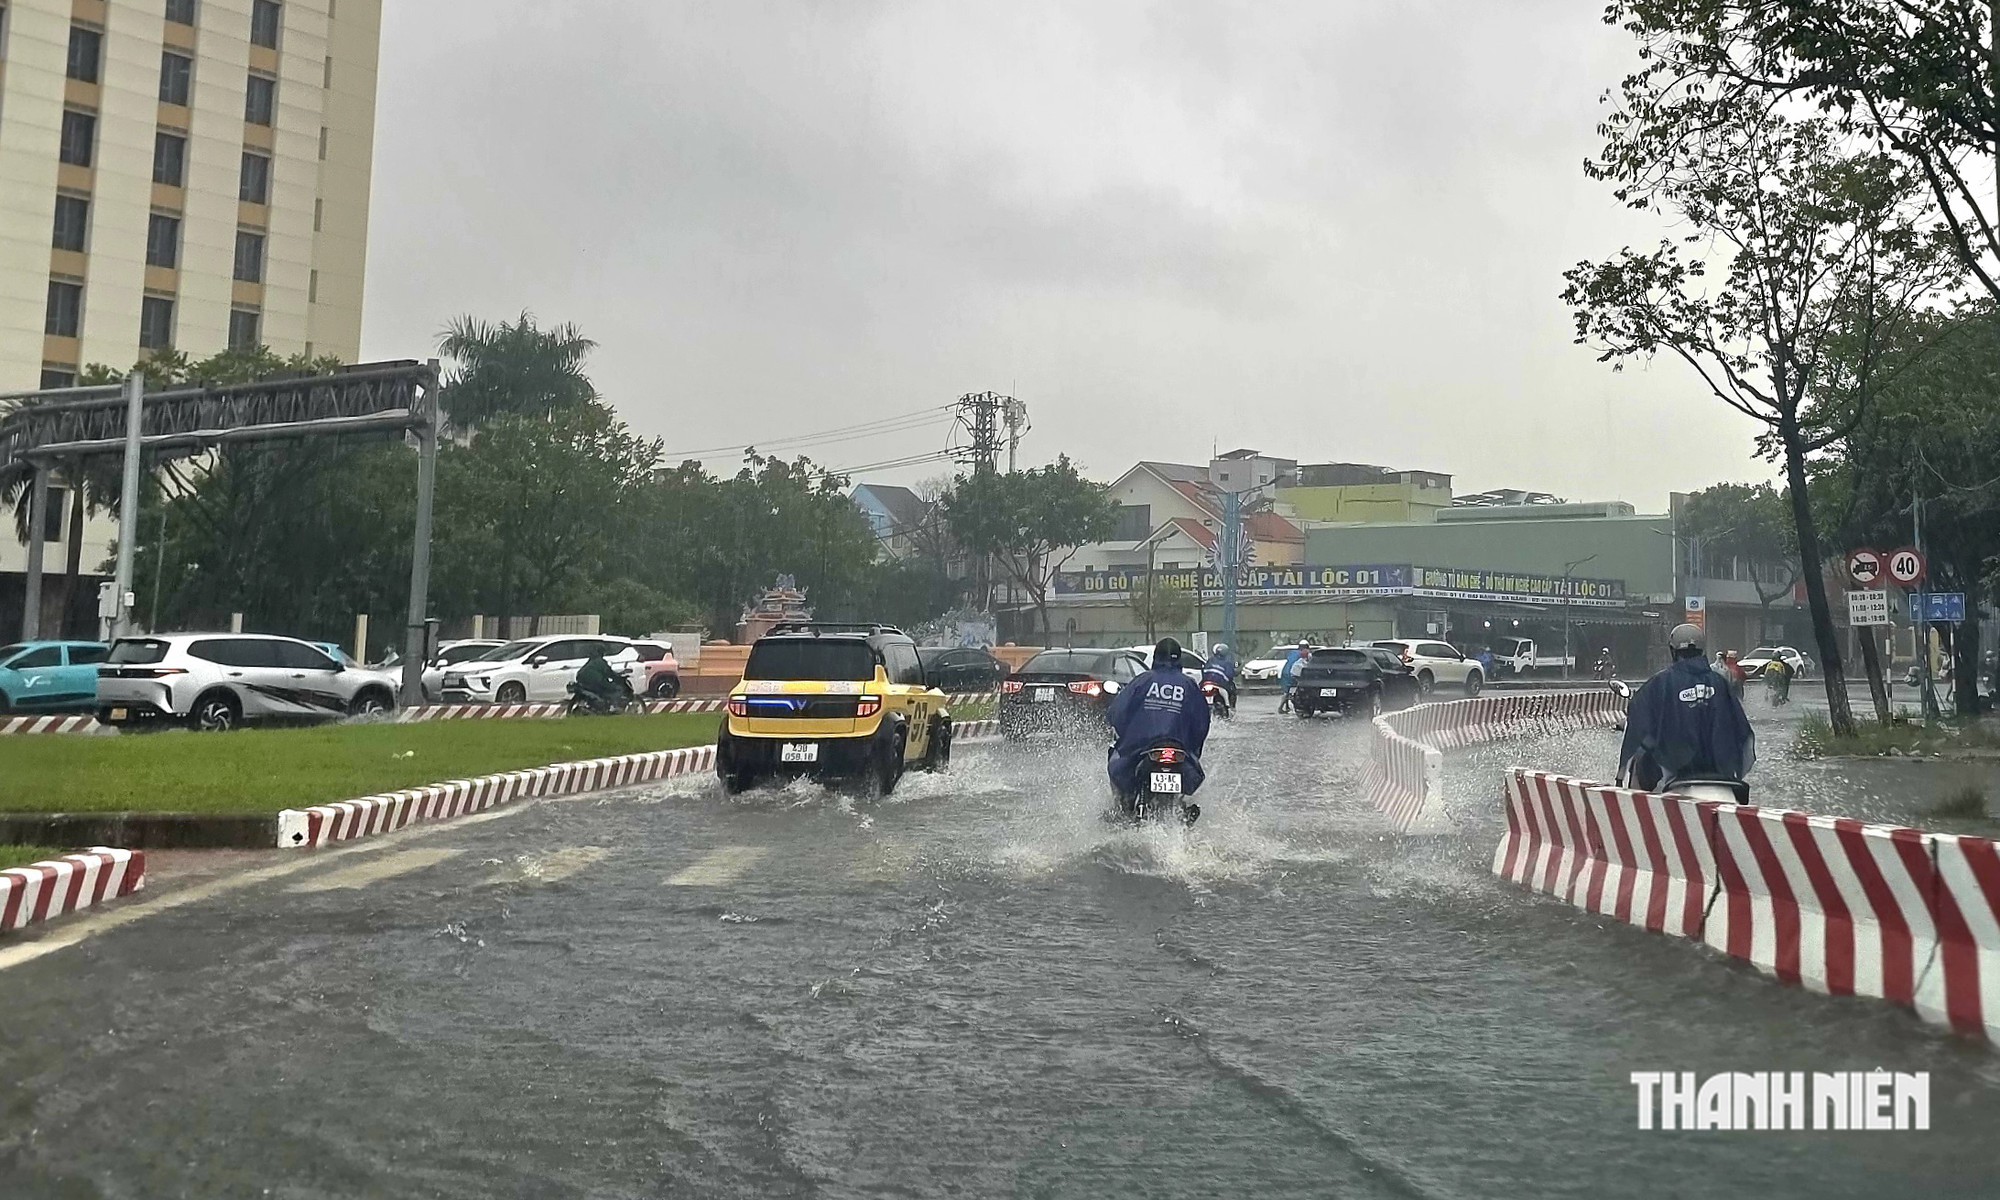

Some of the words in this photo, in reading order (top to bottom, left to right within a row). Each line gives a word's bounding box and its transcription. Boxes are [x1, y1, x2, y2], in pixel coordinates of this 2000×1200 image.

[1897, 557, 1914, 575] 40
[1084, 573, 1104, 590] ĐỒ
[1204, 574, 1229, 589] CA
[1271, 569, 1303, 586] TÀI
[1310, 568, 1349, 588] LỘC
[1356, 570, 1379, 585] 01
[1553, 579, 1571, 596] TÀI
[1575, 580, 1596, 599] LỘC
[1599, 584, 1611, 597] 01
[1146, 682, 1185, 702] ACB
